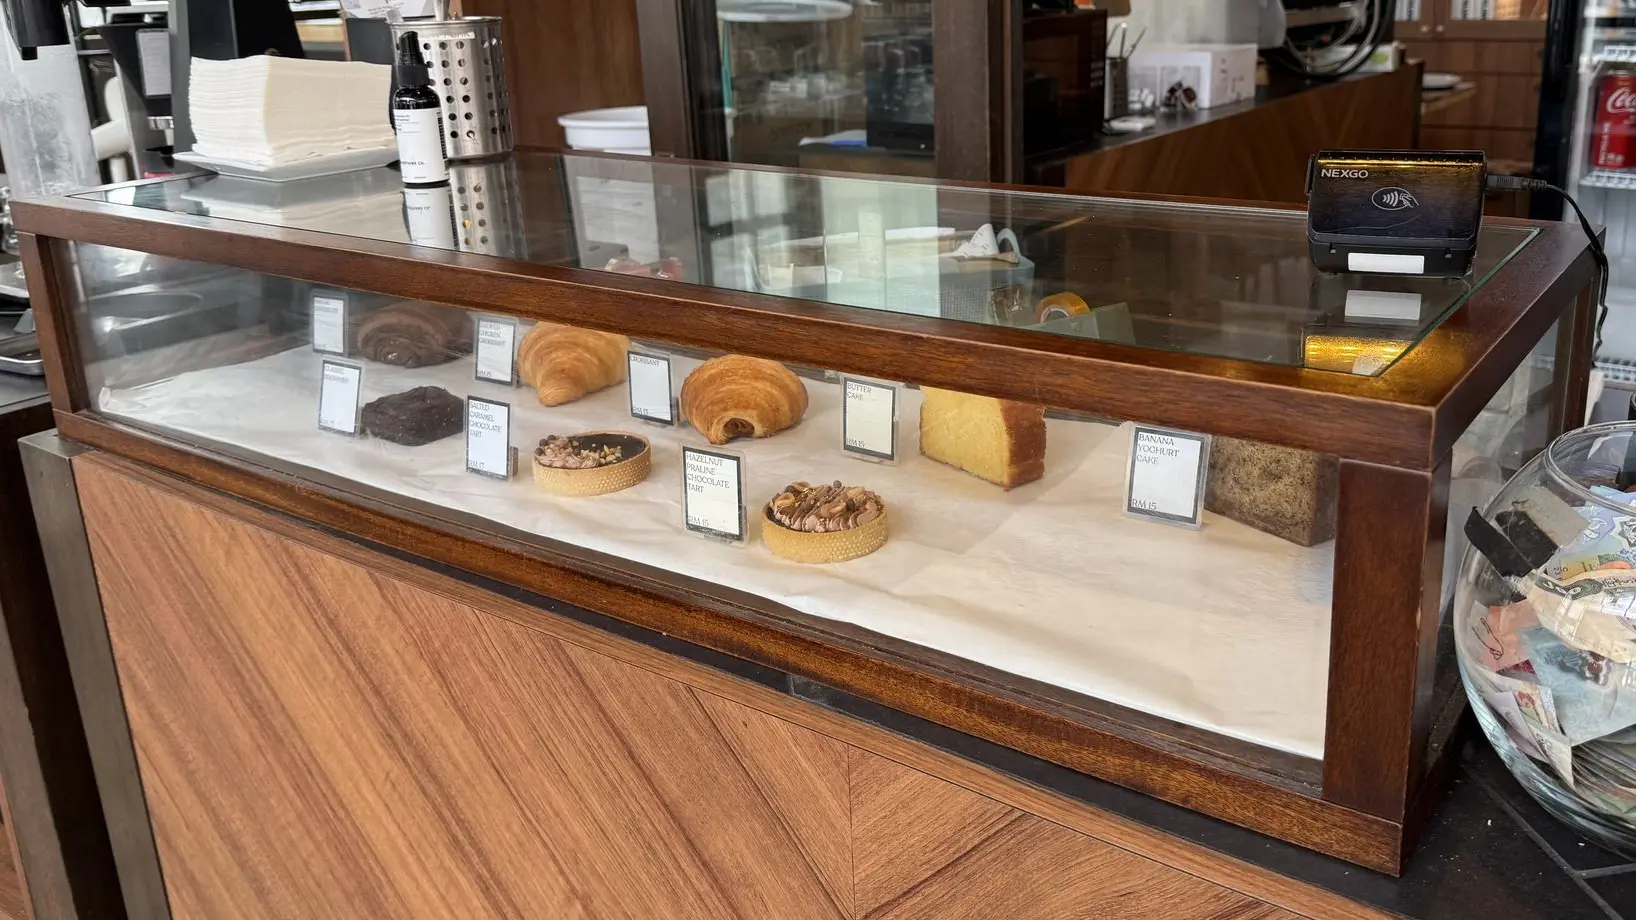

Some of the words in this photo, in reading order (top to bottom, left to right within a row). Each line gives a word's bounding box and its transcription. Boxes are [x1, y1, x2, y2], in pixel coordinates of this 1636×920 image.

[1321, 169, 1368, 178] NEXGO
[630, 354, 660, 367] CROISSANT
[847, 382, 872, 394] BUTTER
[847, 391, 863, 401] CAKE
[470, 401, 490, 411] SALTED
[470, 411, 494, 422] CARAMEL
[470, 420, 501, 432] CHOCOLATE
[470, 429, 482, 438] TART
[1138, 433, 1175, 446] BANANA
[1137, 444, 1180, 457] YOGHURT
[686, 453, 724, 466] HAZELNUT
[1136, 455, 1159, 465] CAKE
[686, 463, 716, 475] PRALINE
[687, 473, 730, 488] CHOCOLATE
[687, 483, 704, 492] TART
[1132, 498, 1146, 508] RM
[1148, 501, 1157, 510] 15
[688, 515, 700, 525] RM
[702, 518, 709, 527] 15
